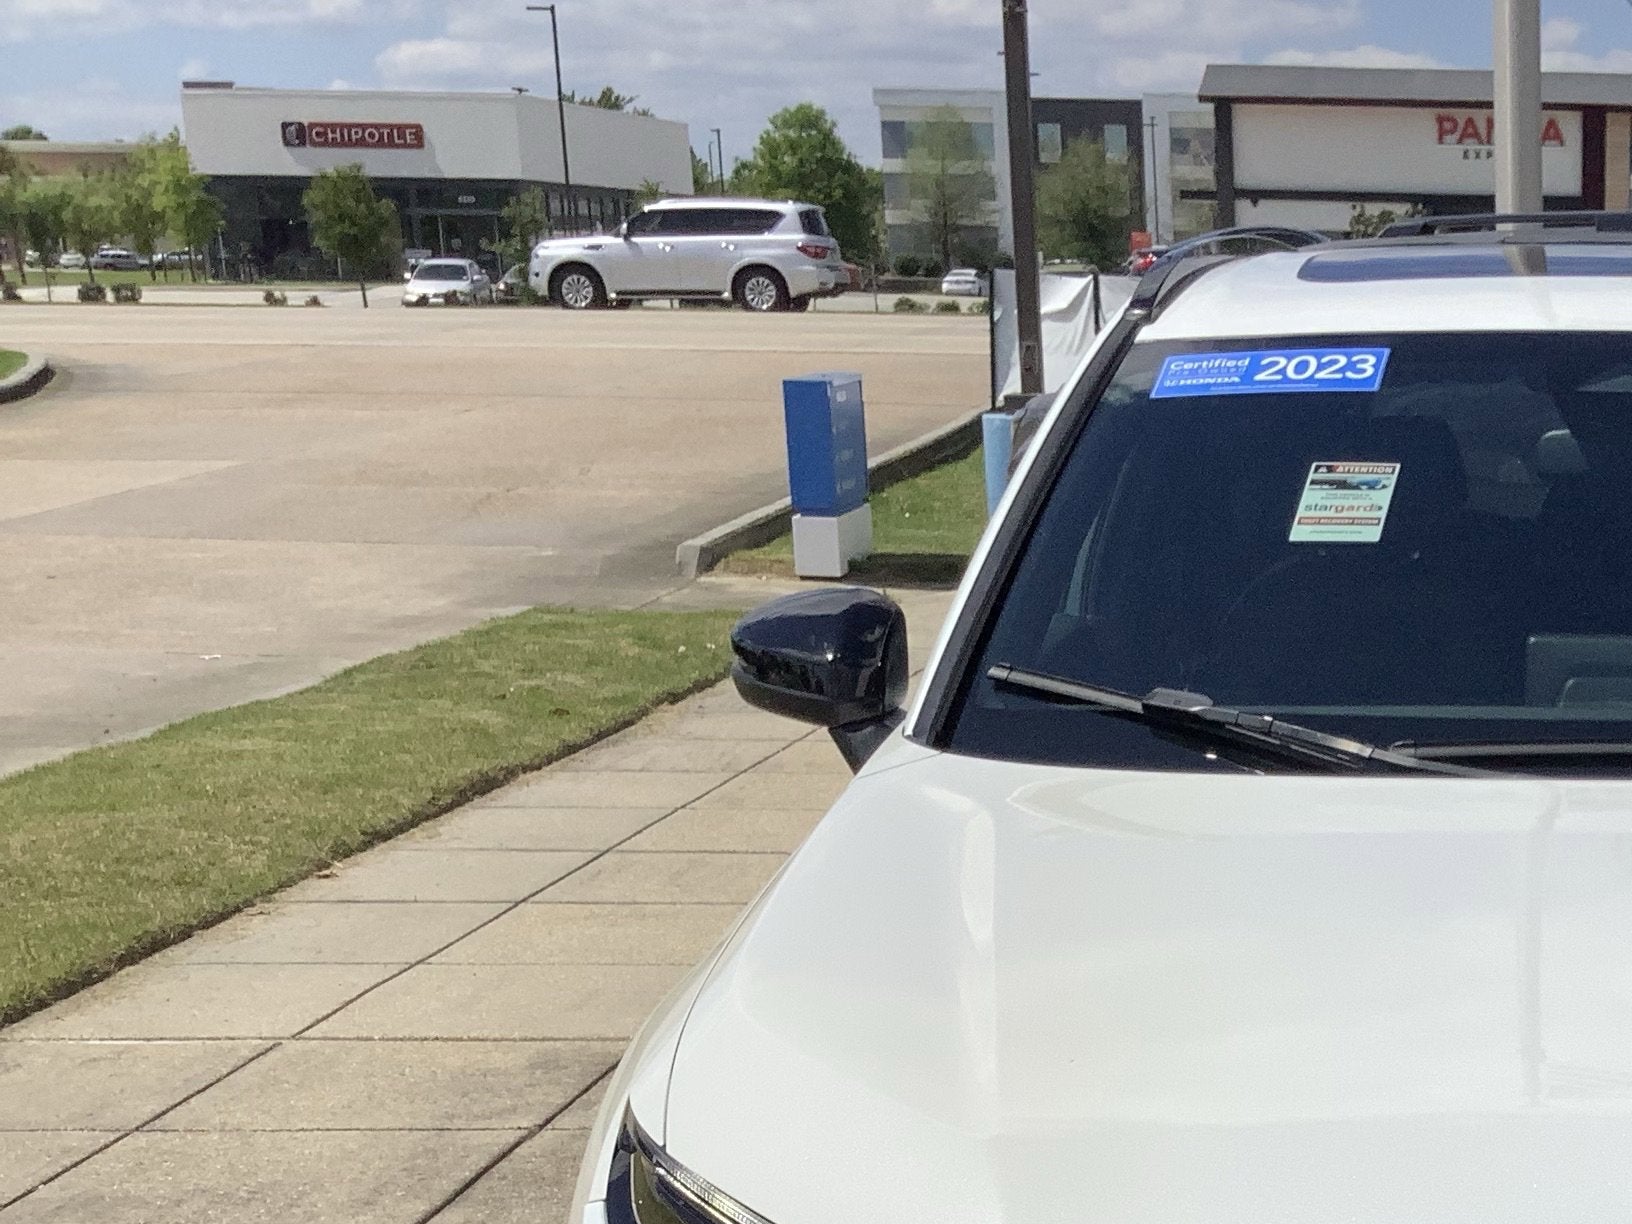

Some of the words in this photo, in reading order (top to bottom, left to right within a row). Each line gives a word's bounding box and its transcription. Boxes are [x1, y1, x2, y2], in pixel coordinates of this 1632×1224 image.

[312, 127, 418, 145] CHIPOTLE
[1435, 113, 1564, 148] PAA
[1170, 357, 1251, 371] Certified
[1253, 355, 1377, 382] 2023
[1178, 376, 1241, 386] HONDA
[1336, 466, 1394, 474] ATTENTION
